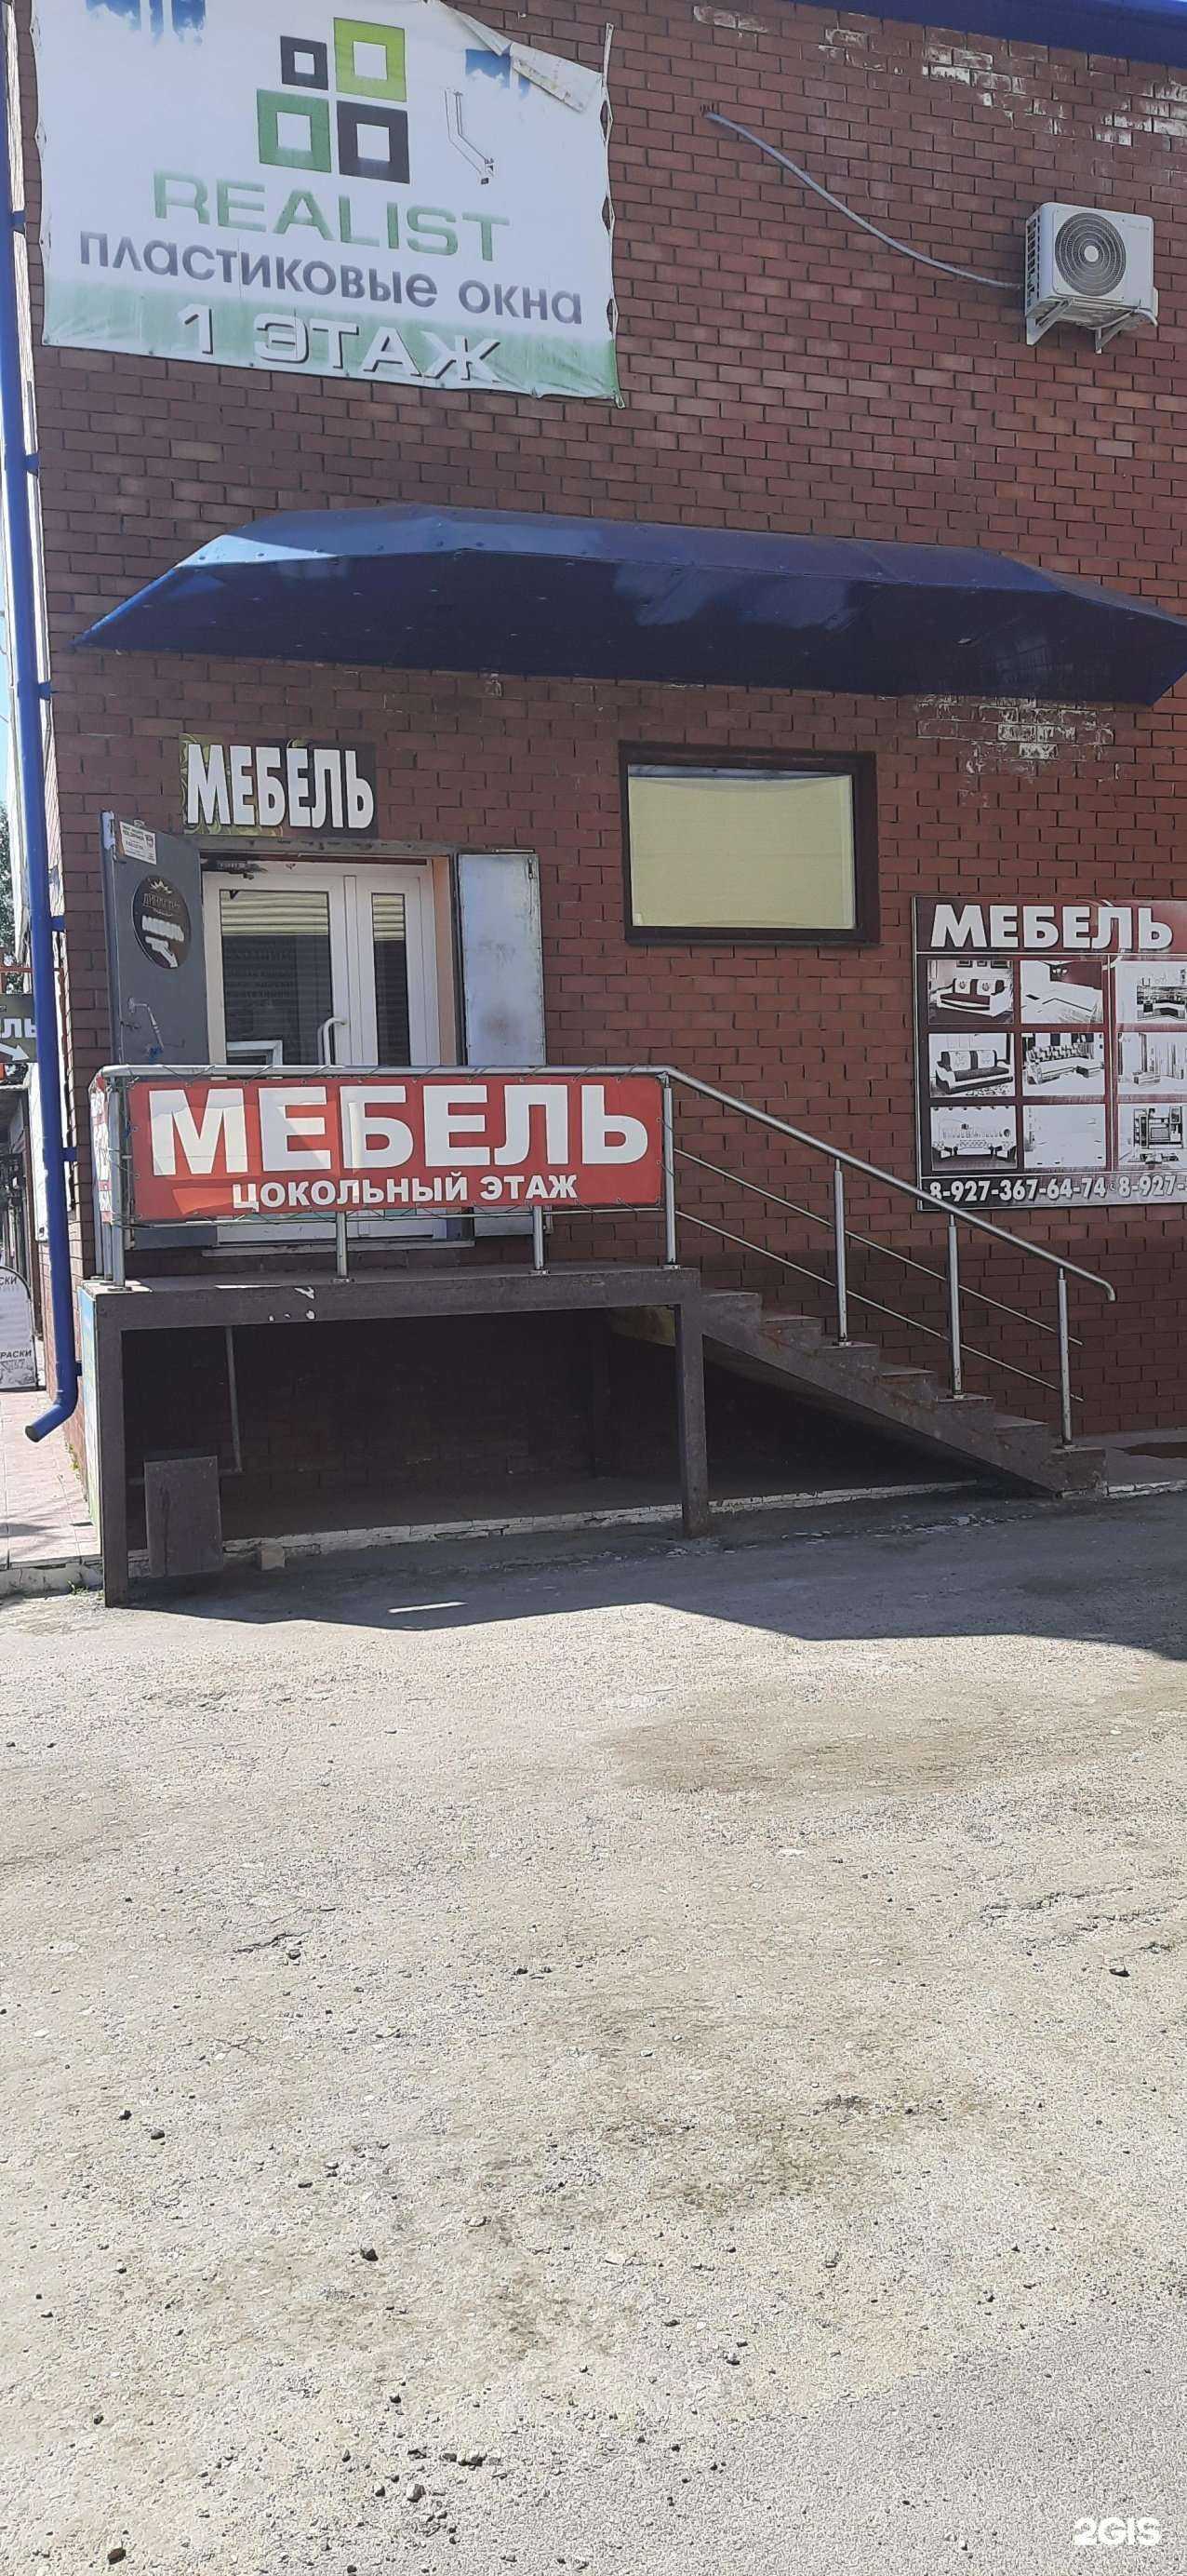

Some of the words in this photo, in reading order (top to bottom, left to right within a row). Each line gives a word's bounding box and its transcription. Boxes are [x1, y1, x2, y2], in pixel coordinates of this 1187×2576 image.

[153, 170, 511, 262] REALIST
[80, 230, 438, 308] пластиковые
[459, 279, 582, 325] окна
[177, 303, 215, 356] 1
[253, 313, 503, 383] ЭТАЖ
[186, 744, 375, 829] МЕБЕЛЬ
[930, 904, 1174, 950] МЕБЕЛЬ
[148, 1084, 648, 1175] МЕБЕЛЬ
[233, 1172, 468, 1213] ЦОКОЛЬНЫЙ
[480, 1174, 579, 1201] ЭТАЖ
[930, 1177, 1107, 1202] 8-927-367-64-74
